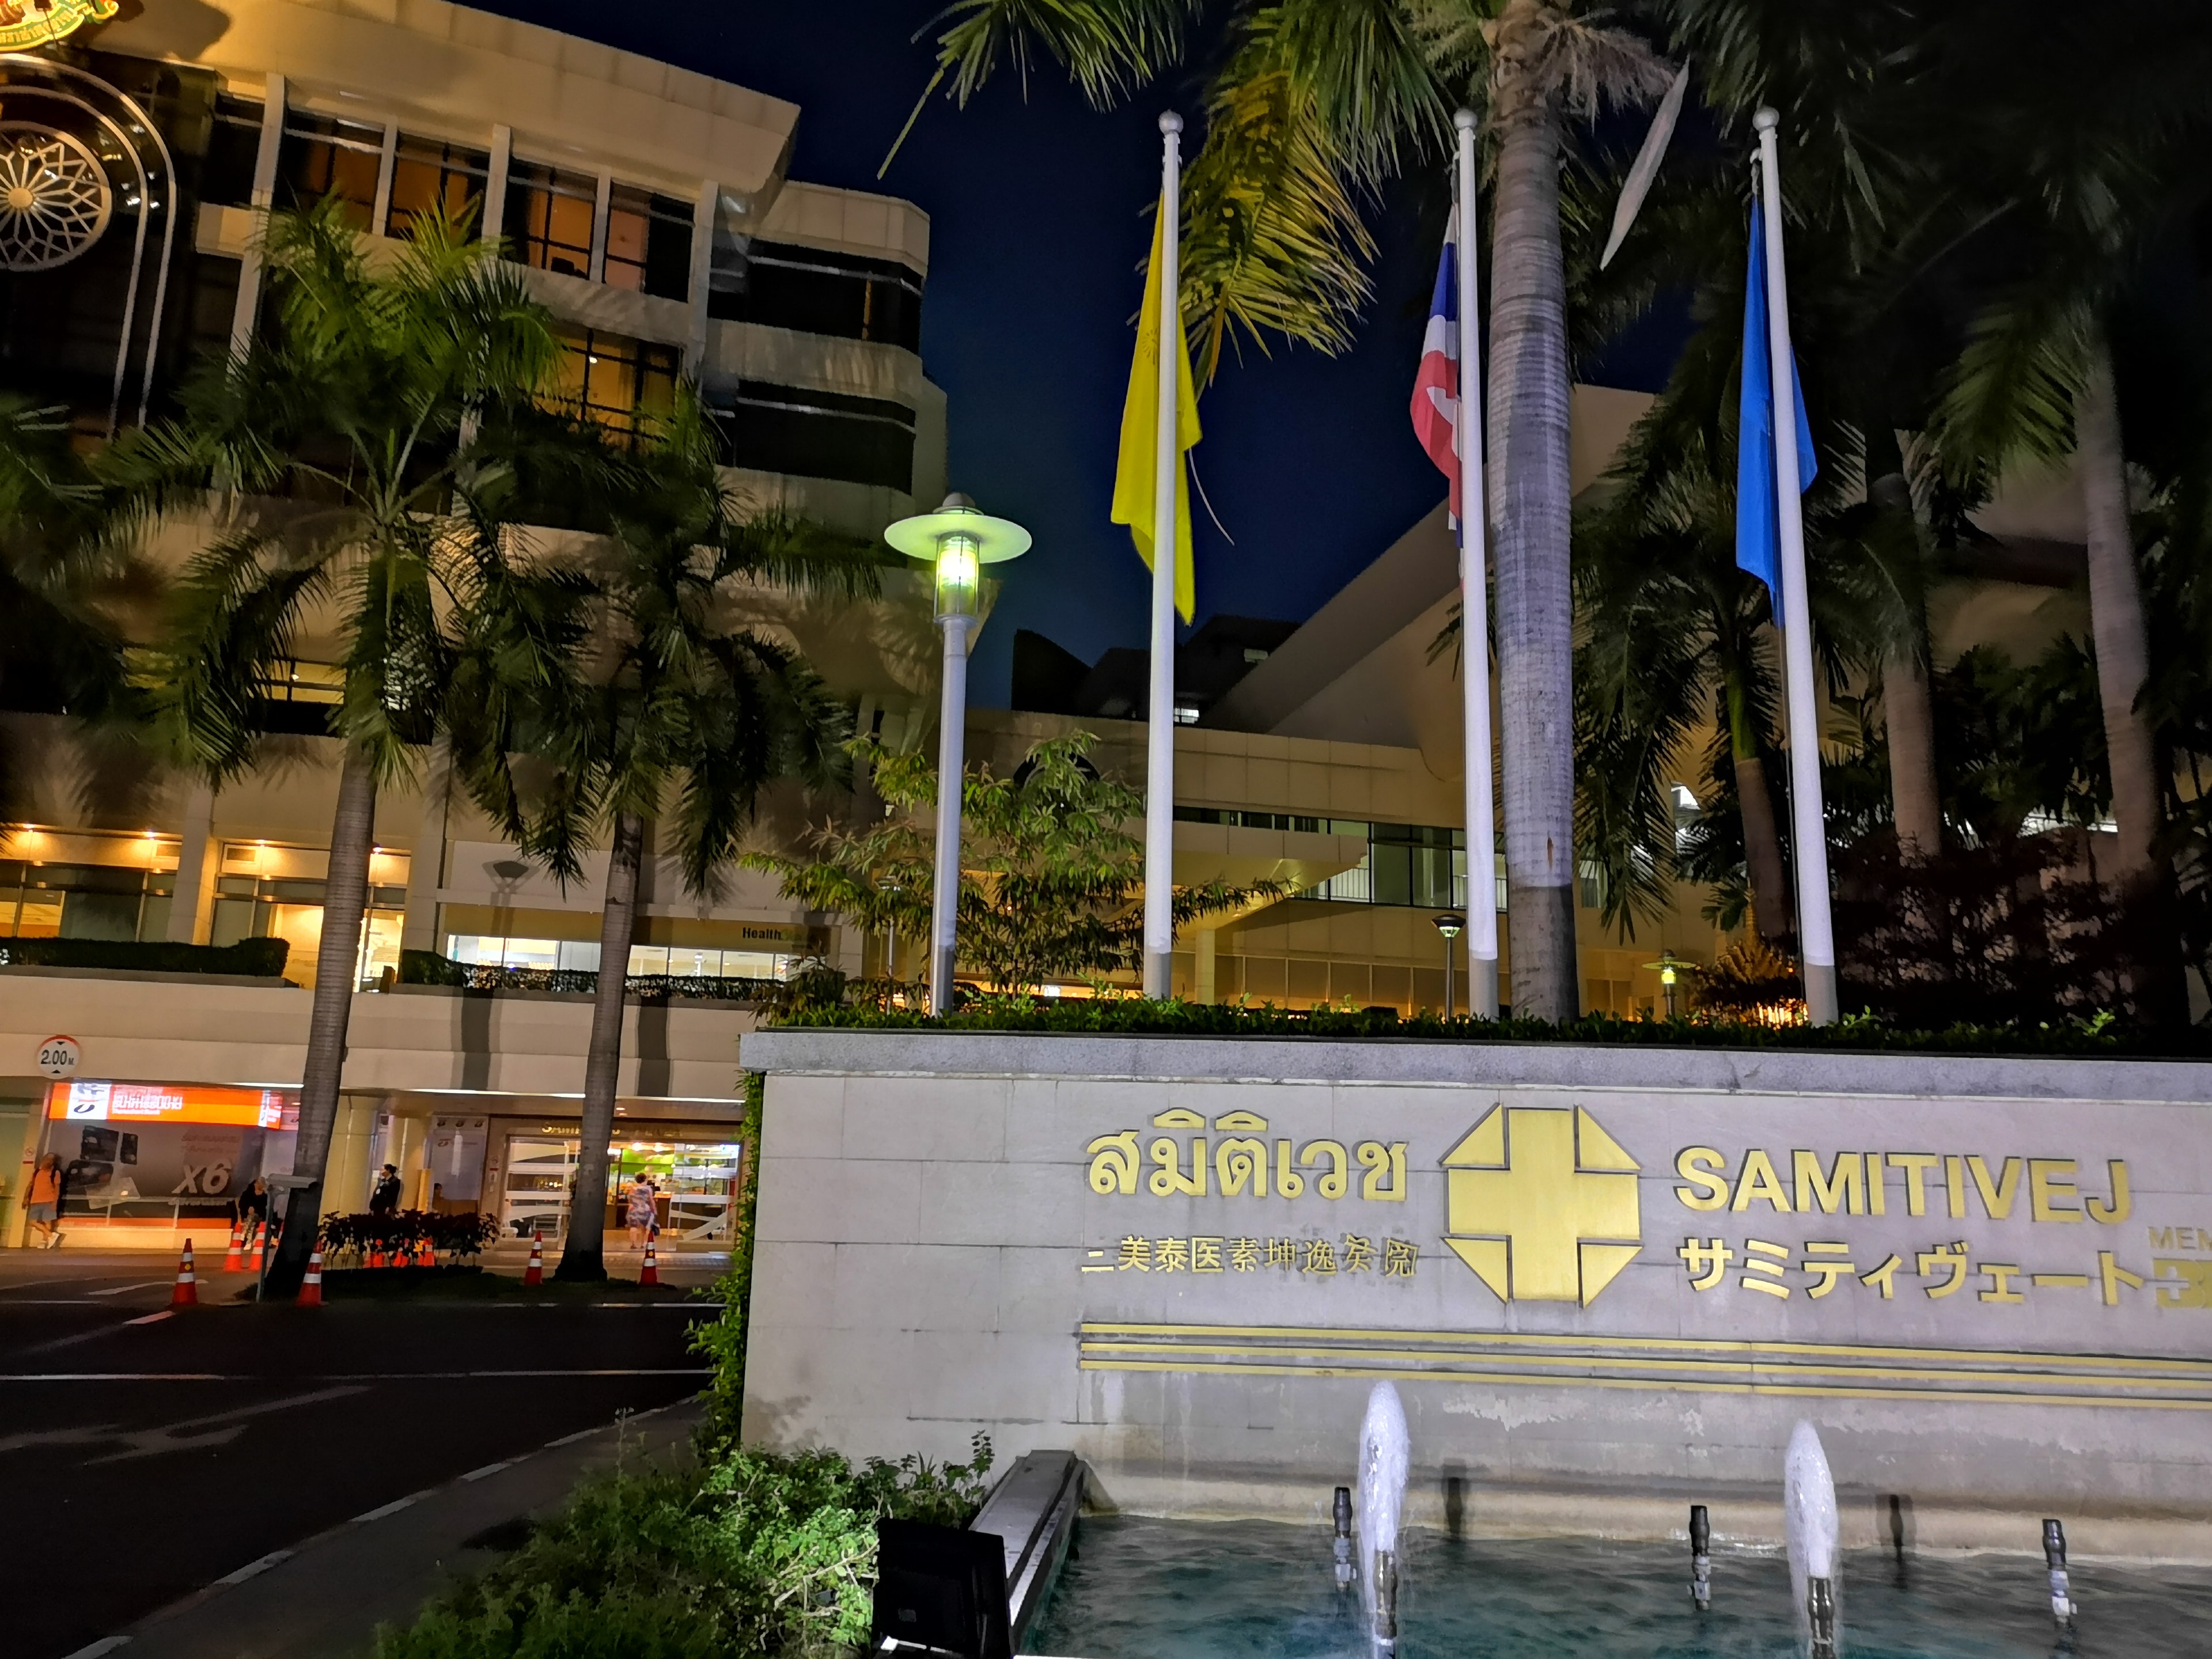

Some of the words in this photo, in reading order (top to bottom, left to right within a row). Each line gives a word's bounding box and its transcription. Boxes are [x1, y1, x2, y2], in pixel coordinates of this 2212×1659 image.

[743, 927, 782, 940] Health
[41, 1049, 67, 1065] 2.00
[1086, 1107, 1408, 1202] สมิติเวช
[1673, 1145, 2130, 1225] SAMITIVEJ
[1676, 1237, 2144, 1306] サミティヴェート
